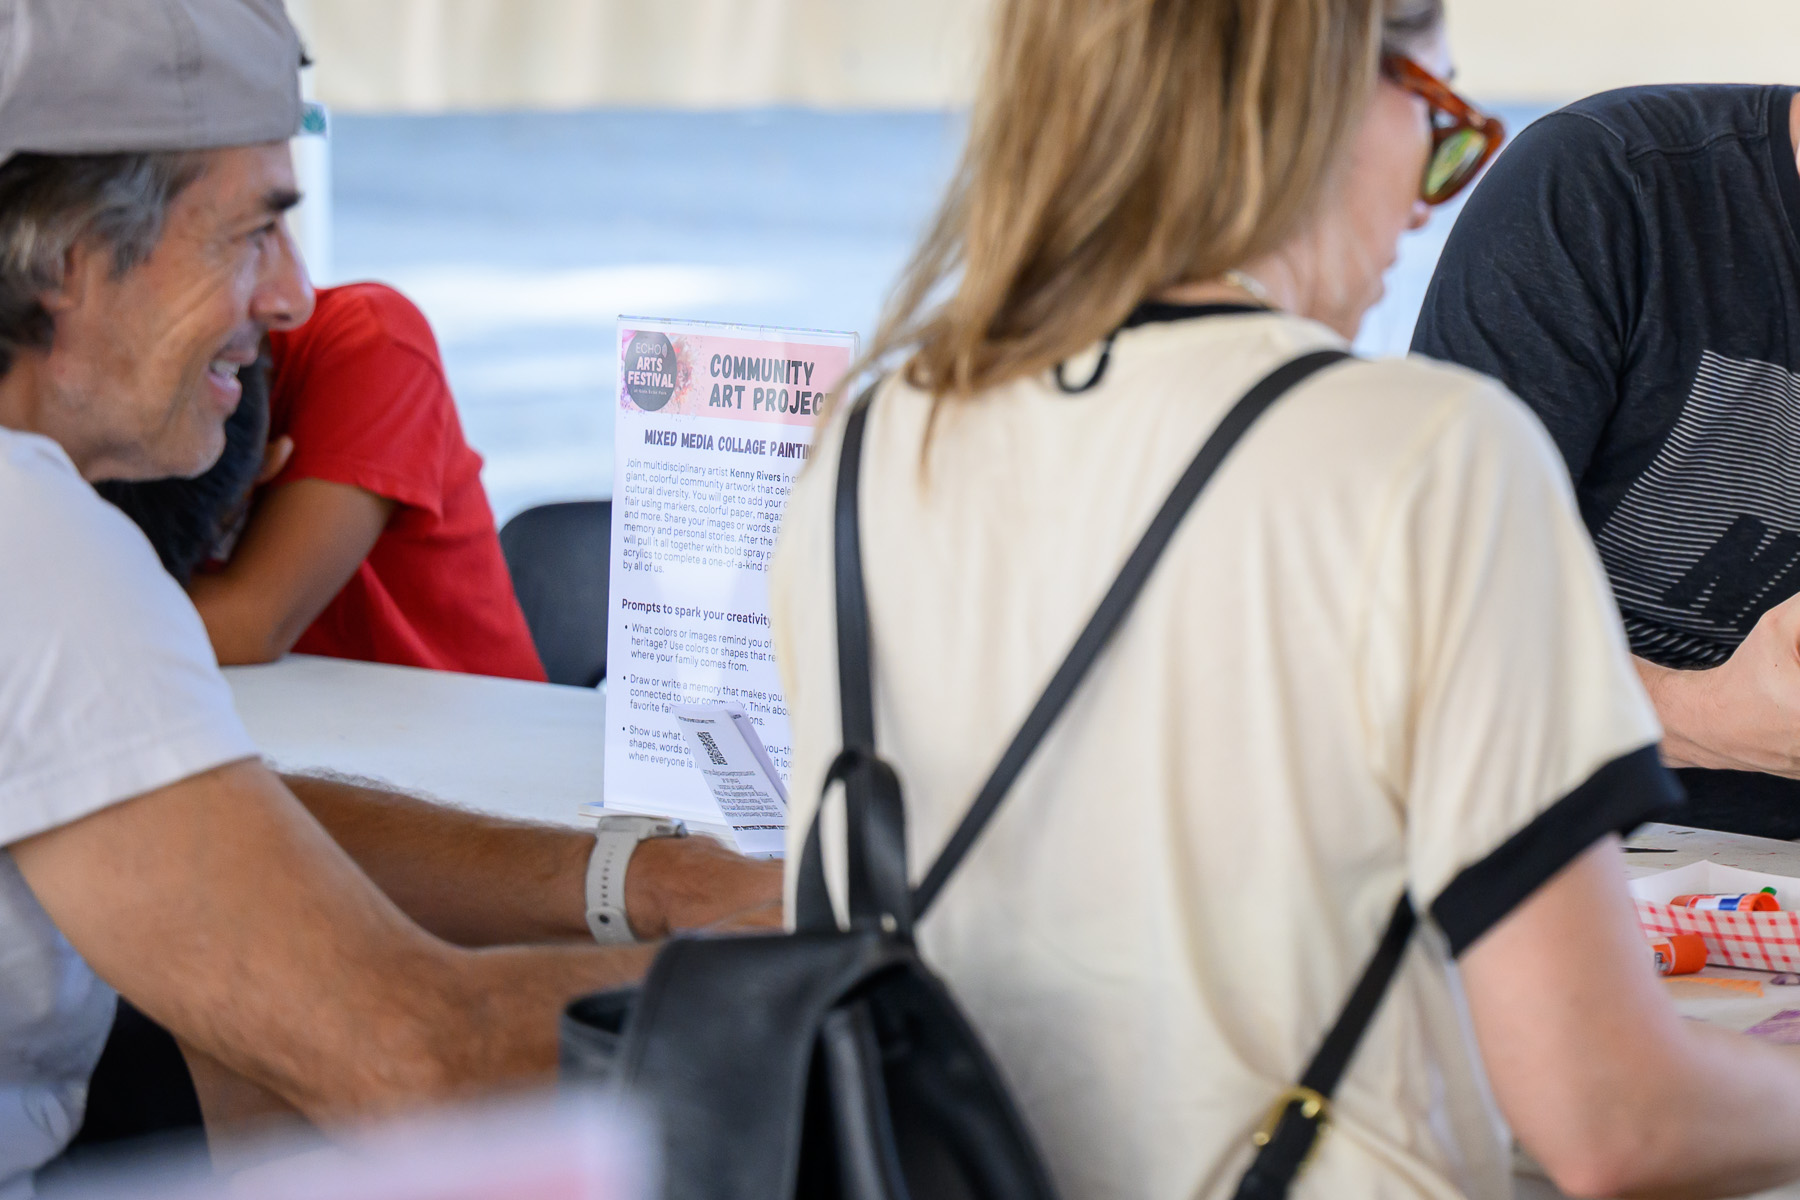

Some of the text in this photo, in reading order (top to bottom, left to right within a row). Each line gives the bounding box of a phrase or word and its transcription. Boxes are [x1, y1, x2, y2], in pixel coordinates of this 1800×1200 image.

[636, 342, 661, 355] ECHO
[636, 356, 662, 372] ARTS
[710, 354, 814, 386] COMMUNITY
[628, 370, 674, 388] FESTIVAL
[709, 384, 746, 410] ART
[644, 429, 678, 447] MIXED
[681, 432, 714, 451] MEDIA
[718, 436, 766, 456] COLLAGE
[626, 458, 641, 468] Join
[644, 460, 706, 476] multidisciplinary
[708, 466, 728, 476] artist
[730, 468, 755, 481] Kenny
[756, 470, 780, 482] Rivers
[783, 473, 790, 483] in
[626, 471, 647, 483] giant,
[649, 474, 678, 484] colorful
[680, 477, 723, 491] community
[726, 481, 755, 492] artwork
[758, 484, 773, 494] that
[625, 485, 654, 495] cultural
[656, 488, 691, 500] diversity.
[693, 490, 707, 500] You
[709, 492, 721, 501] will
[723, 495, 736, 504] get
[738, 496, 746, 504] to
[748, 496, 762, 506] add
[765, 500, 782, 508] your
[625, 496, 639, 506] flair
[642, 499, 662, 511] using
[664, 502, 697, 513] markers,
[699, 505, 728, 515] colorful
[730, 509, 755, 519] paper,
[624, 510, 638, 519] and
[641, 512, 662, 522] more.
[664, 513, 686, 524] Share
[688, 517, 704, 527] your
[707, 517, 735, 530] images
[737, 522, 744, 530] or
[746, 524, 770, 533] words
[624, 523, 655, 535] memory
[657, 526, 672, 535] and
[674, 528, 707, 539] personal
[708, 532, 736, 542] stories.
[739, 534, 758, 544] After
[760, 536, 773, 546] the
[624, 535, 636, 544] will
[638, 536, 651, 546] pull
[653, 537, 658, 546] it
[660, 538, 668, 547] all
[671, 540, 704, 551] together
[706, 544, 722, 553] with
[724, 546, 741, 555] bold
[744, 548, 765, 560] spray
[623, 548, 652, 559] acrylics
[654, 551, 662, 560] to
[664, 553, 700, 564] complete
[709, 558, 762, 571] one-of-a-kind
[623, 560, 664, 573] by all of us.
[622, 598, 772, 628] Prompts to spark your creativity
[632, 623, 652, 634] What
[654, 626, 677, 637] colors
[689, 630, 716, 643] images
[719, 635, 746, 645] remind
[748, 639, 762, 648] you
[764, 639, 772, 648] of
[632, 636, 667, 650] heritage?
[670, 641, 683, 650] Use
[686, 643, 709, 654] colors
[721, 647, 748, 659] shapes
[750, 650, 766, 661] that
[631, 649, 748, 672] where your family comes from.
[630, 674, 650, 685] Draw
[662, 679, 681, 688] write
[690, 682, 721, 696] memory
[723, 686, 739, 696] that
[741, 689, 766, 700] makes
[769, 693, 782, 703] you
[630, 689, 672, 700] connected
[674, 693, 681, 702] to
[683, 696, 699, 704] your
[750, 702, 770, 713] Think
[630, 699, 659, 712] favorite
[629, 725, 650, 736] Show
[662, 730, 680, 740] what
[629, 739, 657, 751] shapes,
[660, 744, 682, 754] words
[629, 752, 649, 761] when
[651, 755, 685, 767] everyone
[687, 758, 692, 768] is
